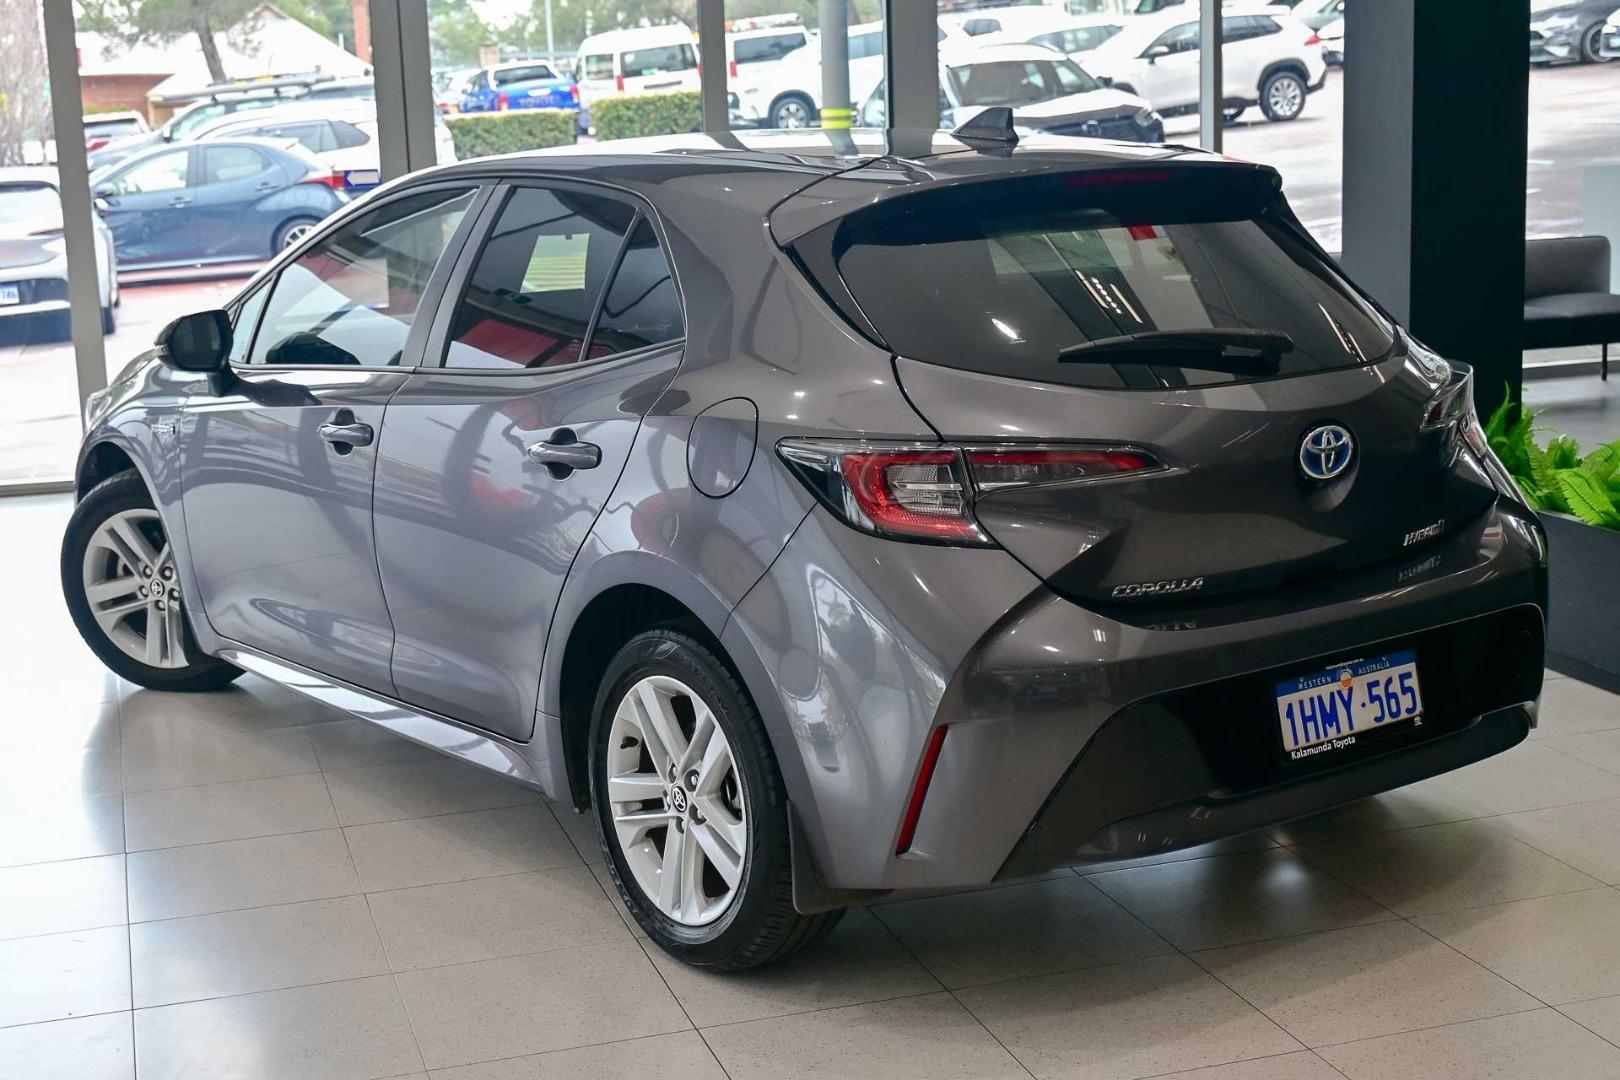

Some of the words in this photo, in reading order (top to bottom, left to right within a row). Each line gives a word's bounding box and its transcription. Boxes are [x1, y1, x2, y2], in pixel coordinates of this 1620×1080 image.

[1111, 576, 1204, 599] COROLLA
[1298, 676, 1332, 690] WESTERN
[1358, 660, 1391, 674] AUSTRALIA
[1291, 742, 1332, 760] Kalamunda
[1333, 736, 1356, 751] Toyota
